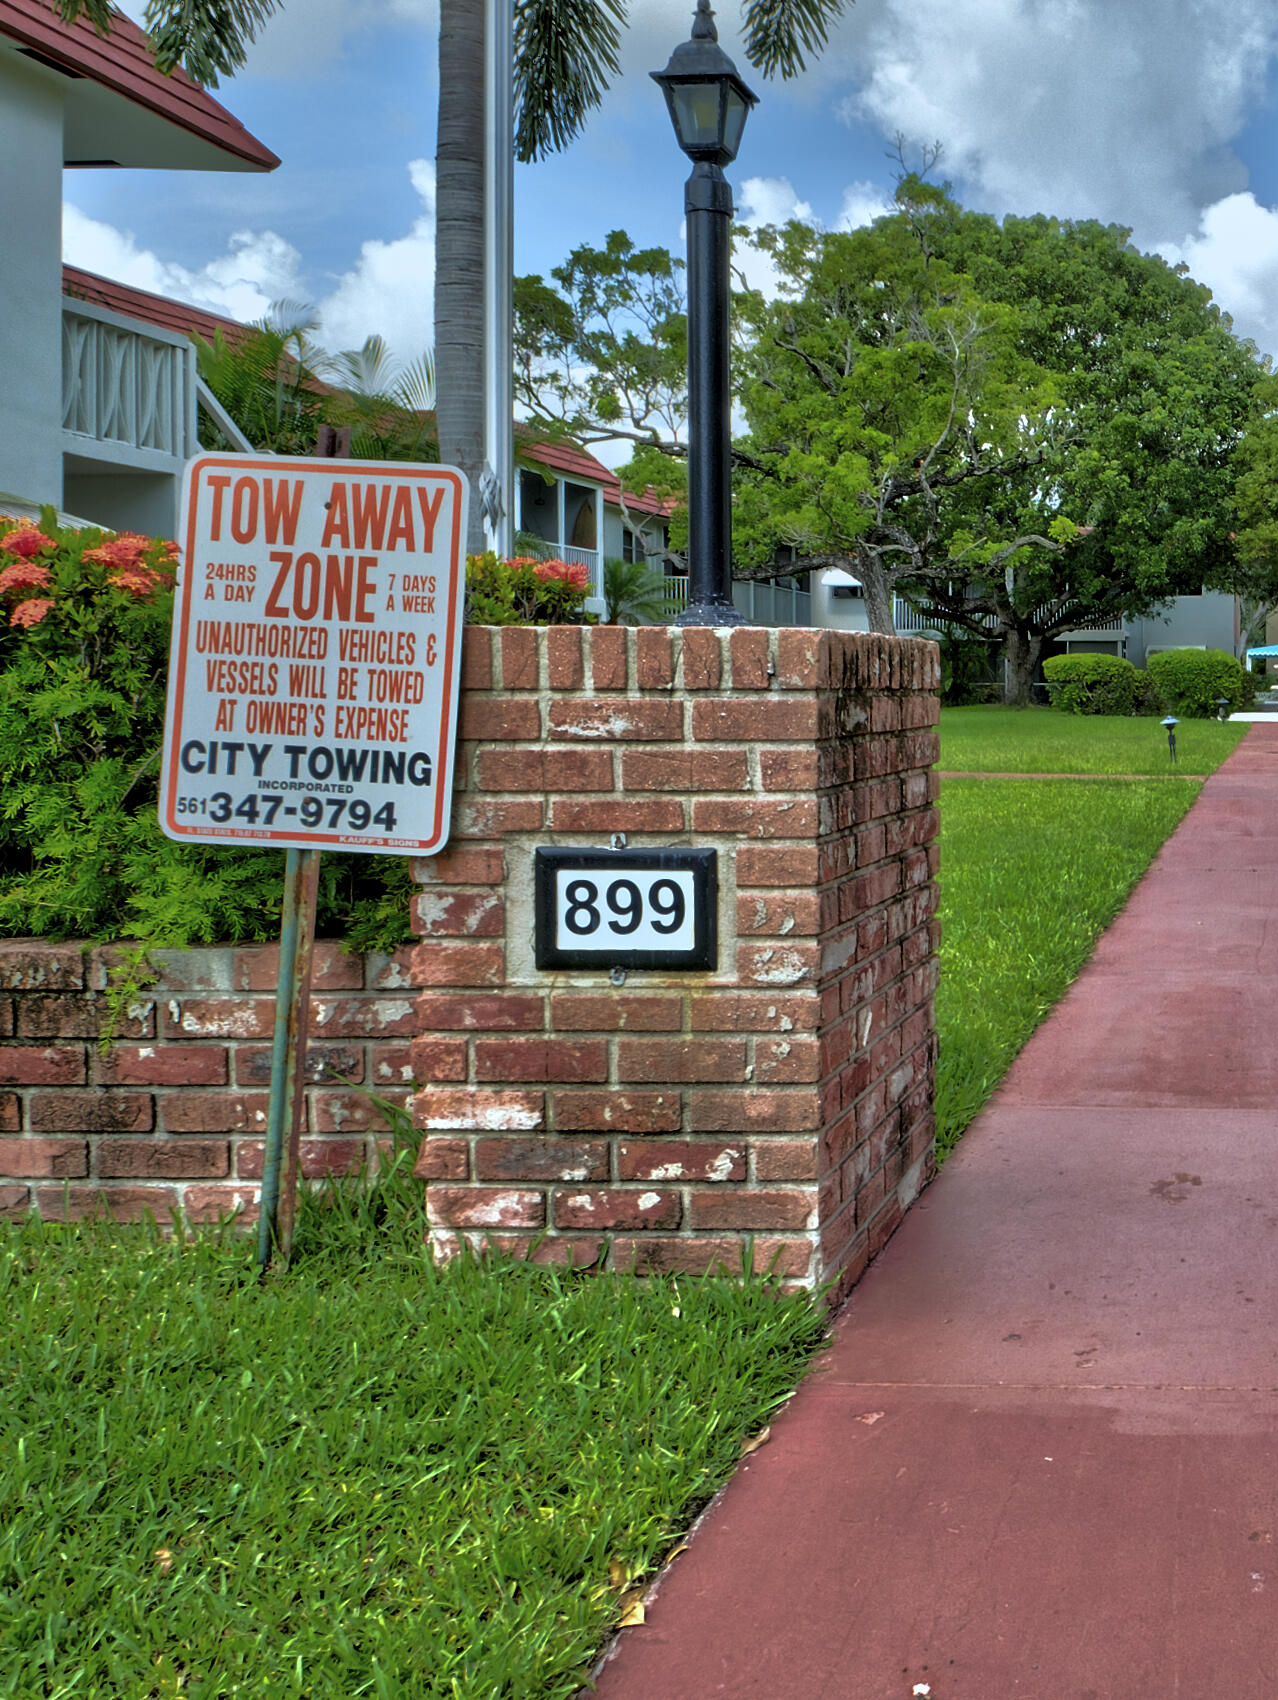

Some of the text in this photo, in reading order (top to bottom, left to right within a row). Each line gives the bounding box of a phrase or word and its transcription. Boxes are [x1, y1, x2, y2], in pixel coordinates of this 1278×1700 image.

[207, 475, 446, 553] TOW AWAY
[204, 584, 256, 602] A DAY
[206, 563, 257, 582] 24HRS
[265, 551, 379, 623] ZONE
[388, 574, 436, 593] 7 DAYS
[386, 595, 435, 613] A WEEK
[195, 620, 438, 667] UNAUTHORIZED VEHICLES &
[206, 659, 424, 705] VESSELS WILL BE TOWED
[215, 699, 409, 743] AT OWNER'S EXPENSE
[181, 740, 432, 787] CITY TOWING
[257, 780, 354, 794] INCORPORATED
[177, 792, 397, 832] 561 347-9794
[388, 839, 420, 848] SIGNS
[565, 879, 685, 935] 899
